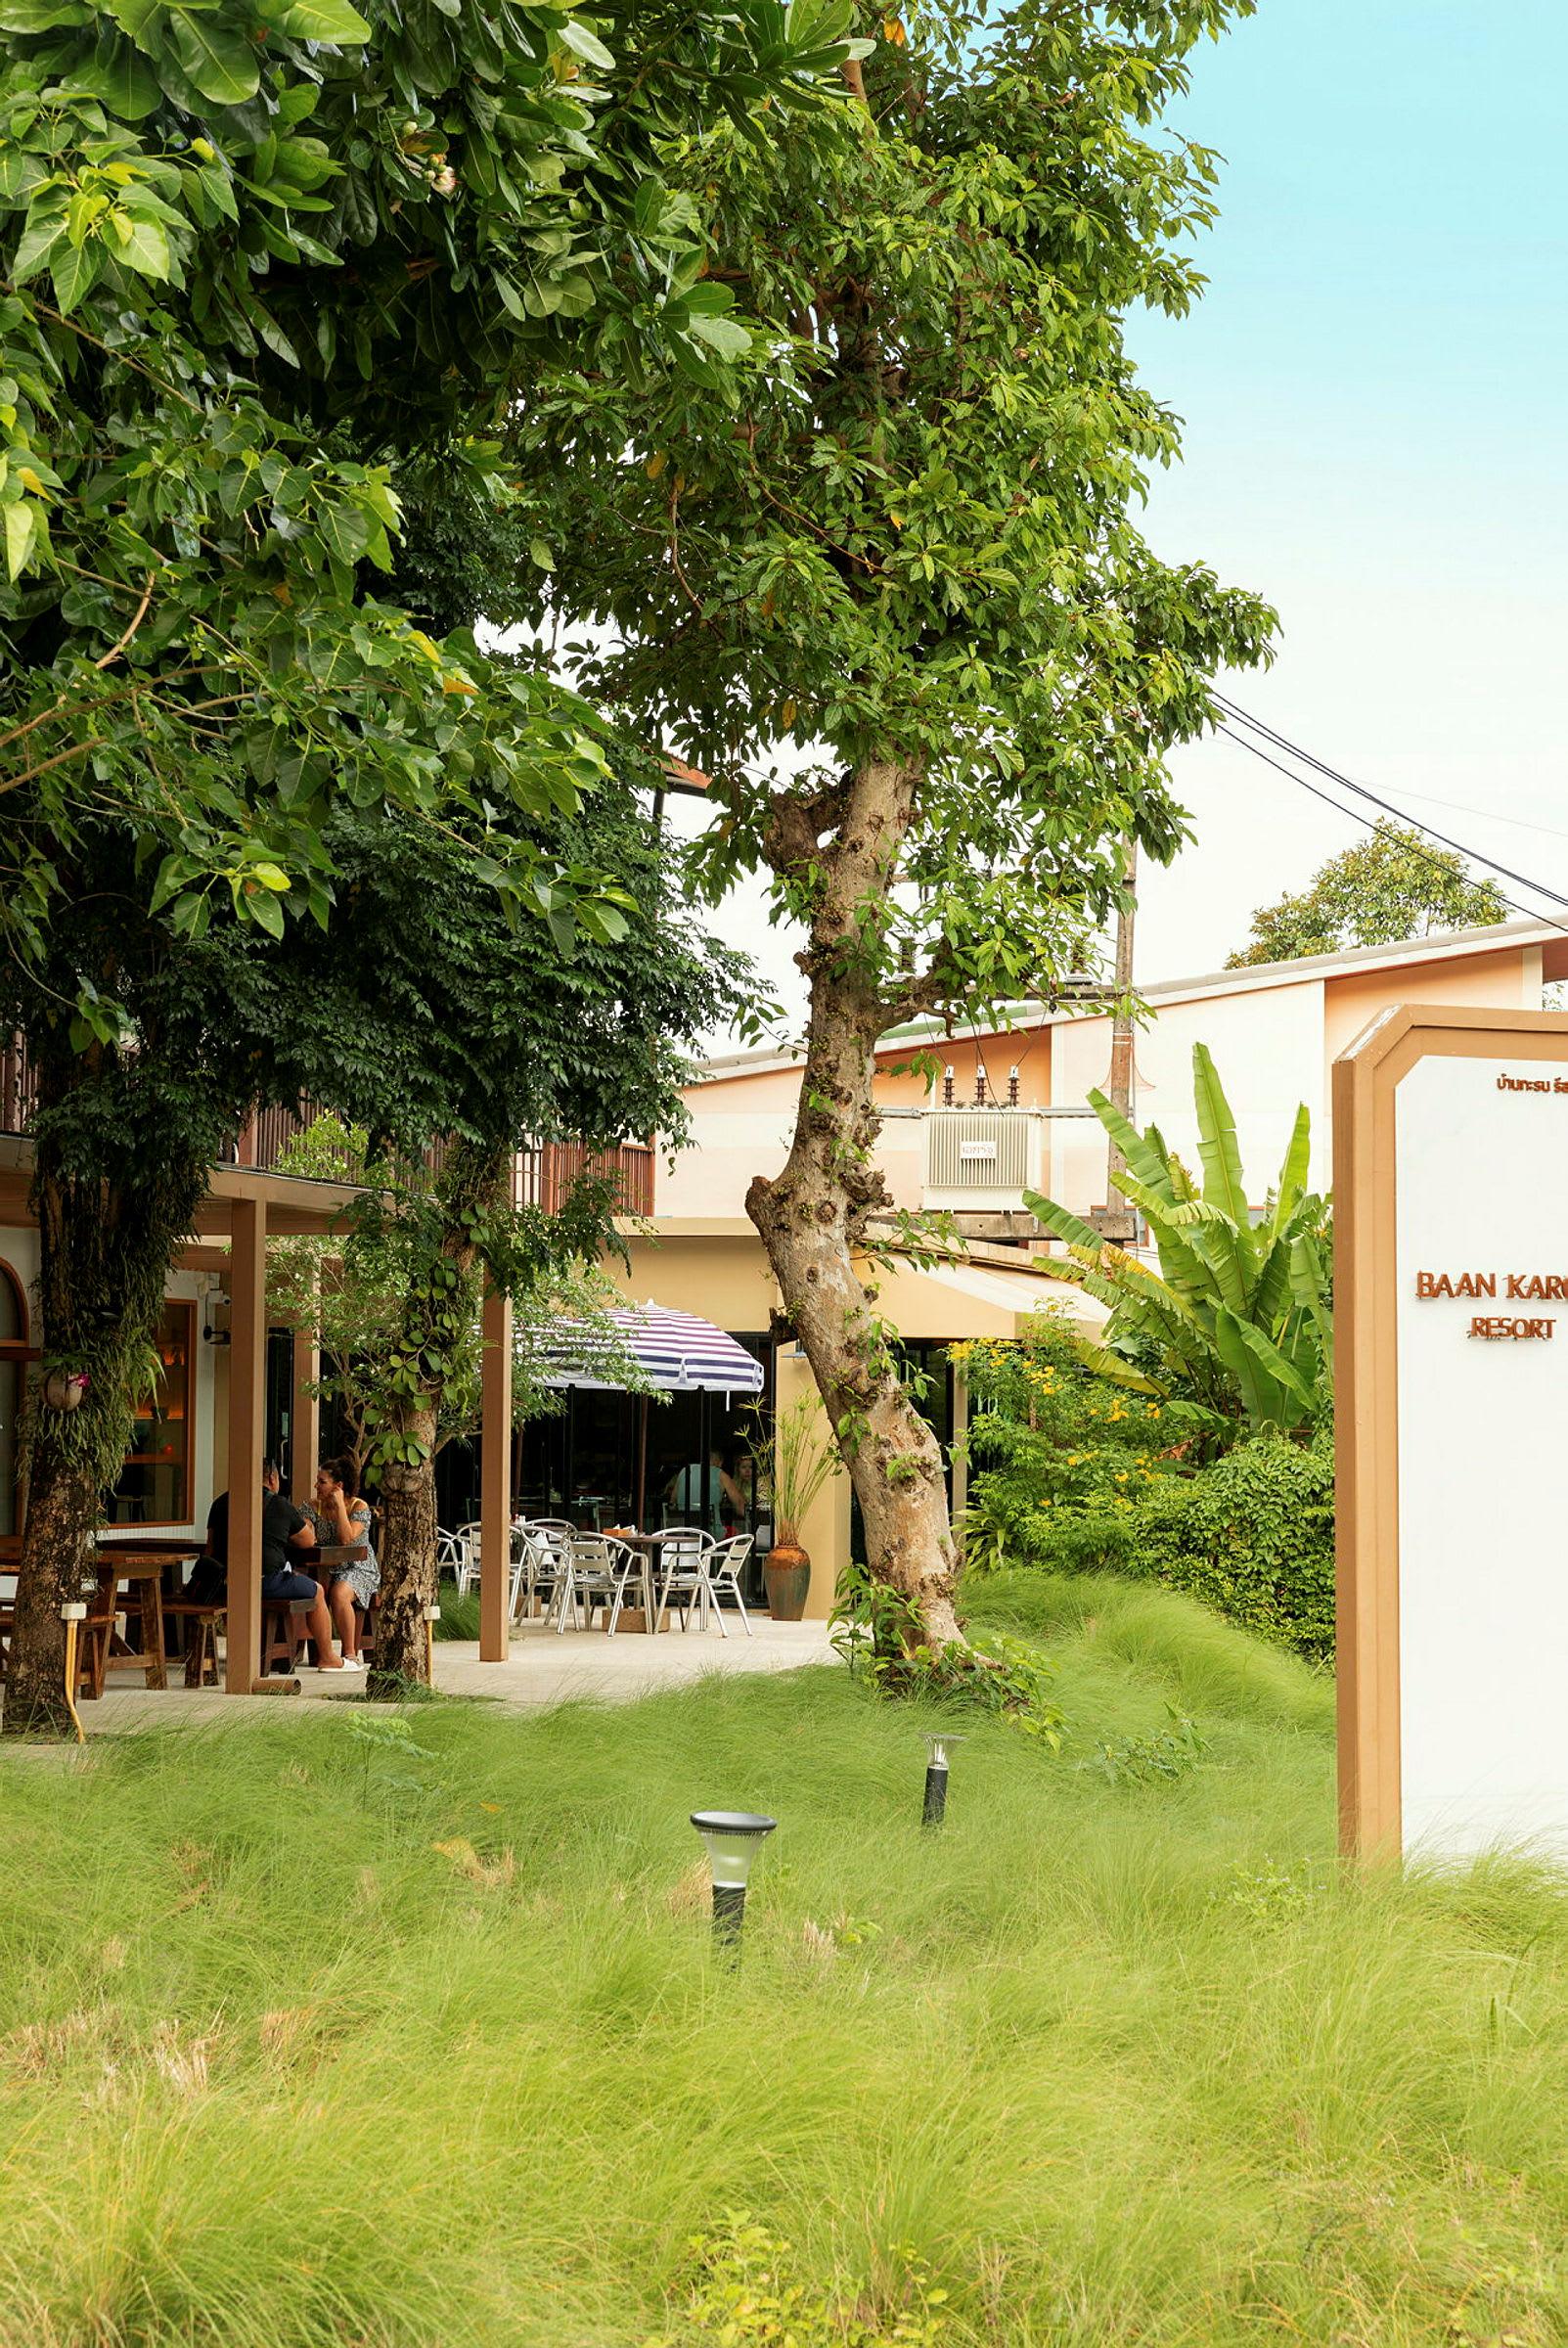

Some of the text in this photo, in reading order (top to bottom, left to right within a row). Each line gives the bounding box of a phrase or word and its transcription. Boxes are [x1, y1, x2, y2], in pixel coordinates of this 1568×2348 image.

[1416, 1273, 1568, 1300] BAAN KAR
[1470, 1317, 1557, 1339] RESORT
